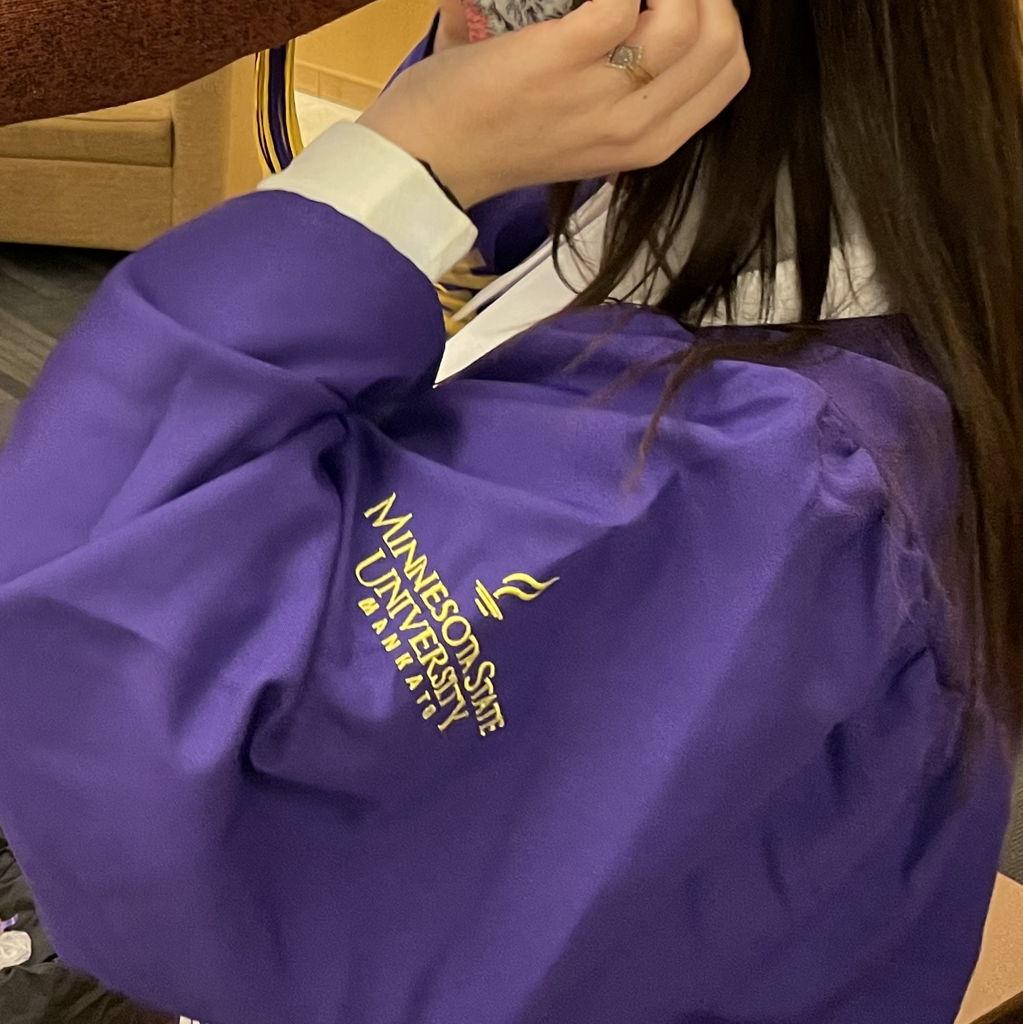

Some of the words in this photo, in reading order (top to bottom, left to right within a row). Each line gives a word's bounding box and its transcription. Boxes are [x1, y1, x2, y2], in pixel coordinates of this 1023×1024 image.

[355, 548, 469, 732] UNIVERSITY
[358, 597, 437, 720] MANKATO
[364, 492, 480, 674] MINNESOTA
